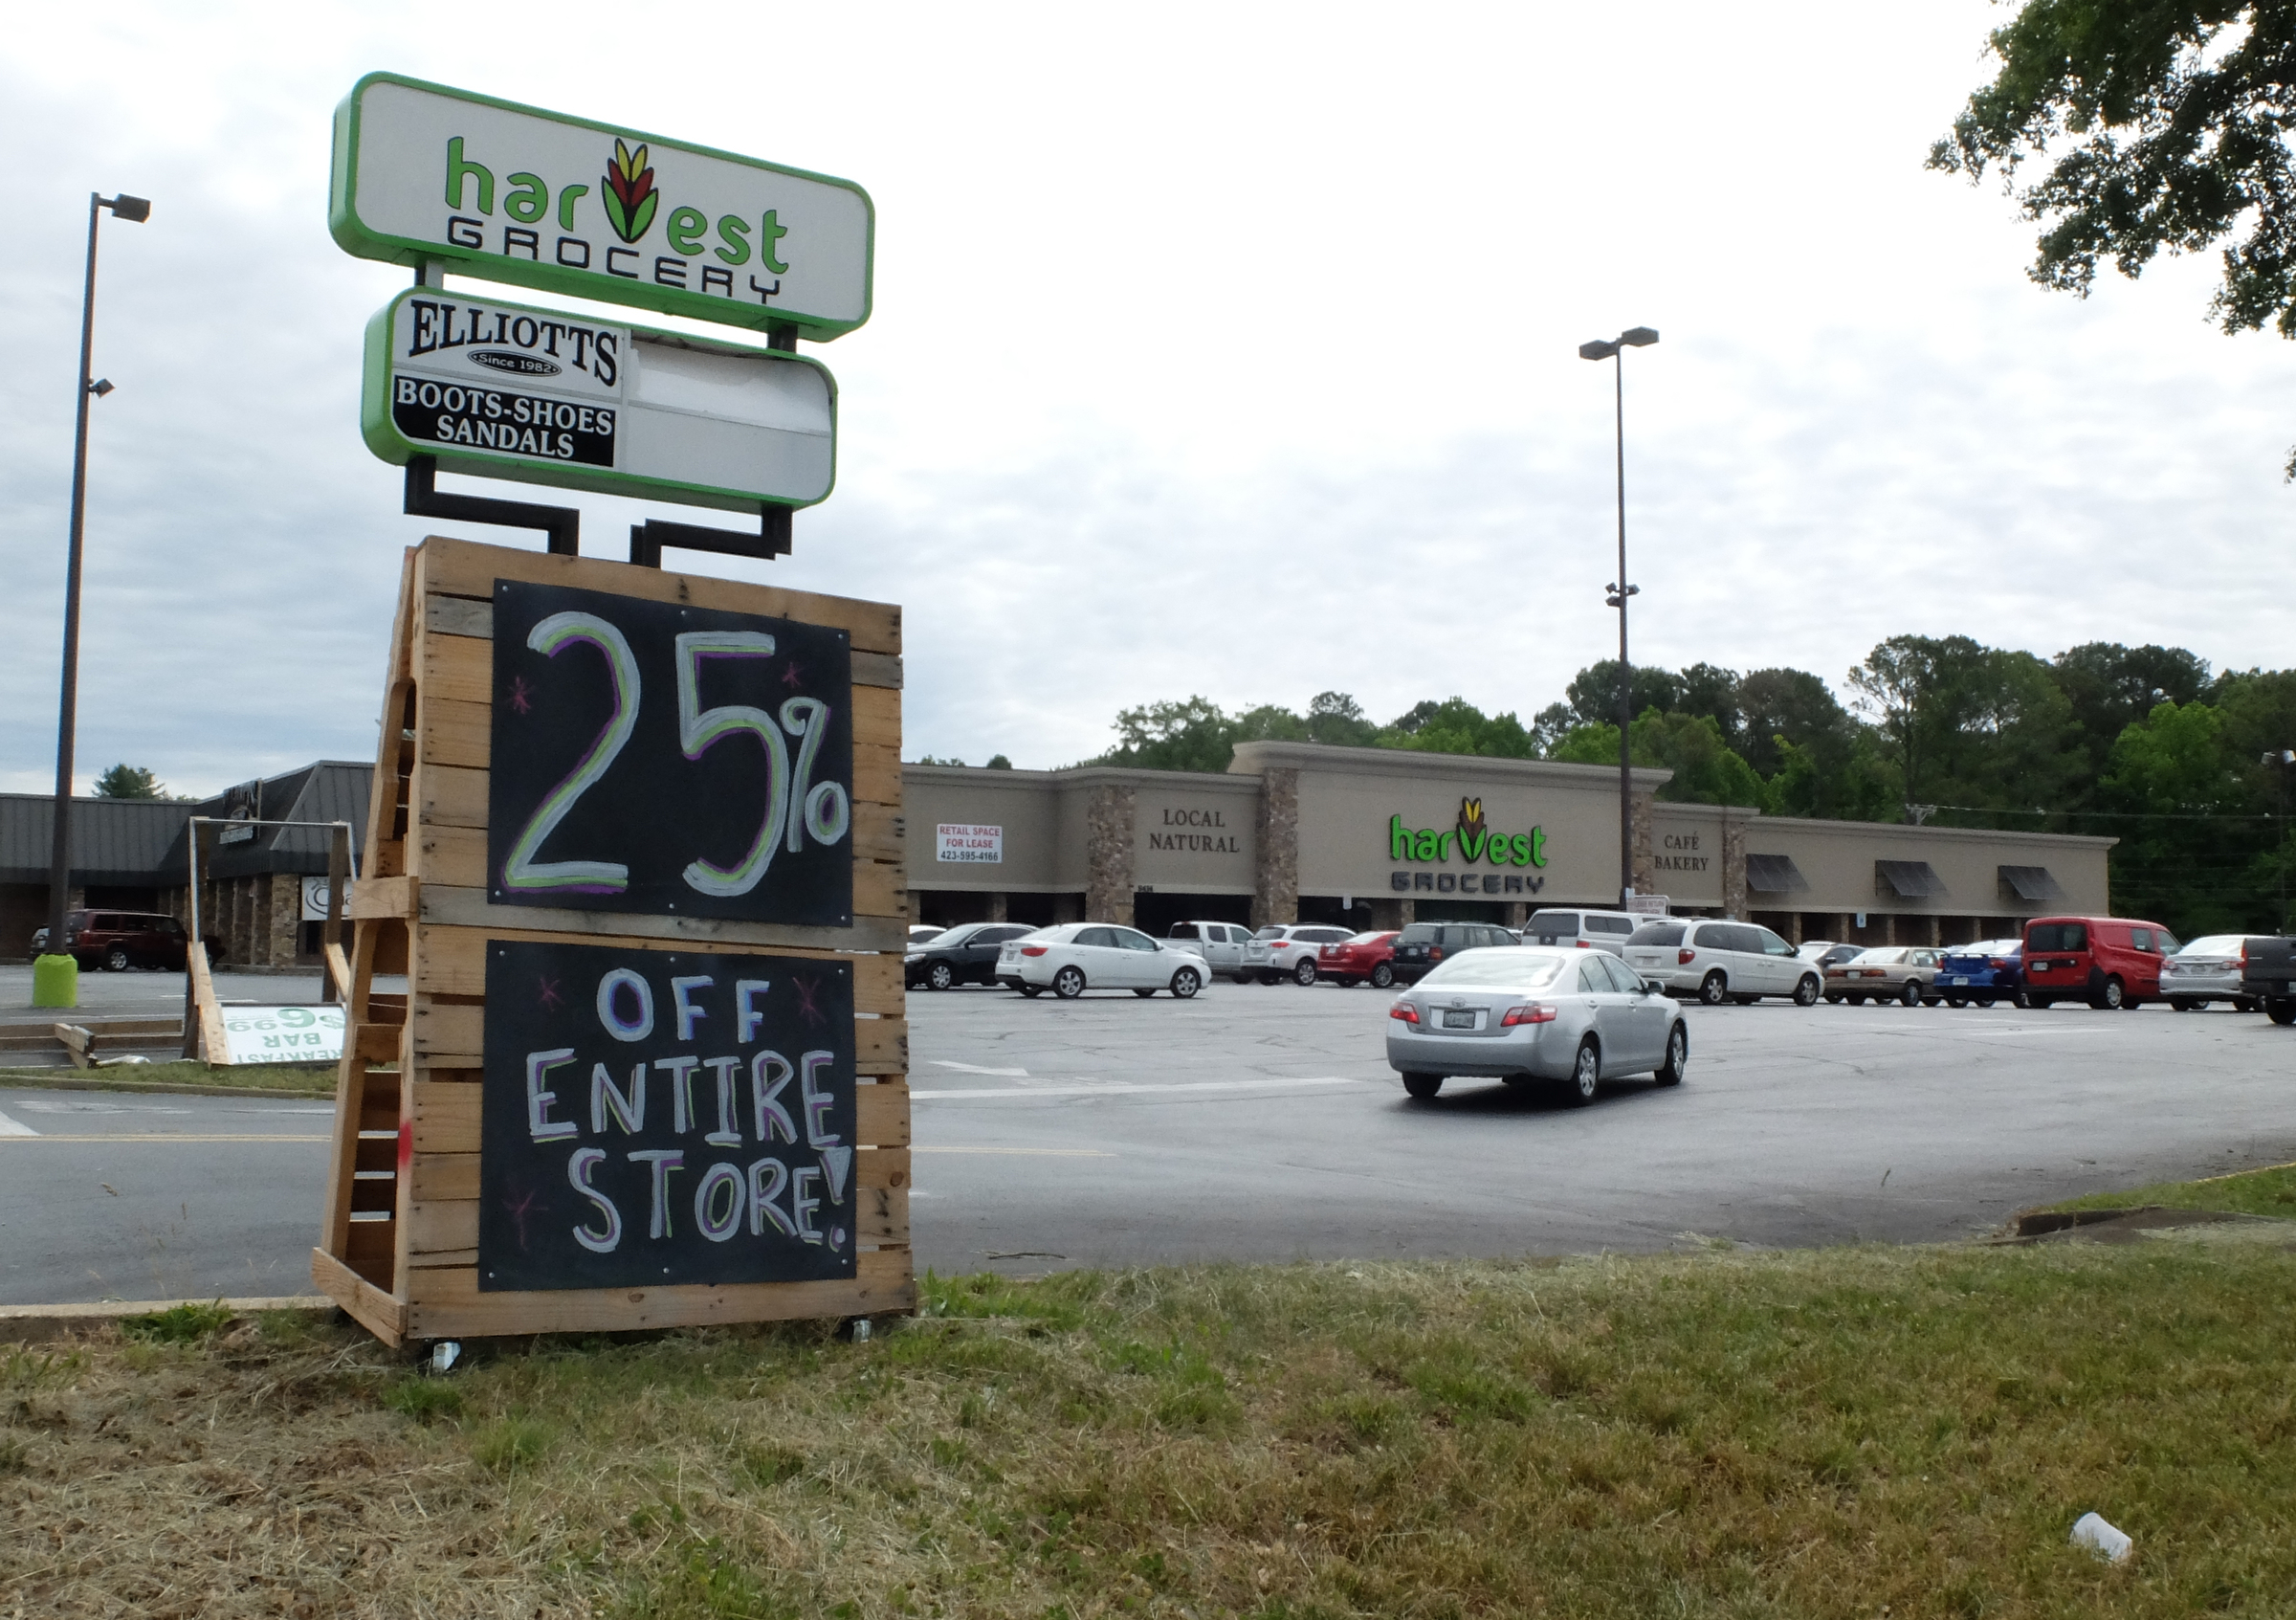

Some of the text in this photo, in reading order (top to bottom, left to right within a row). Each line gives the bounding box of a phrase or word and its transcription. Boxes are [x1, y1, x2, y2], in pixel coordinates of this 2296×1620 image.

[447, 215, 781, 304] GROCERY
[408, 299, 617, 388] ELLIOTTS
[478, 353, 552, 373] Since 1982
[397, 378, 613, 436] BOOTS-SHOES
[436, 414, 575, 459] SANDALS
[500, 610, 850, 898] 25%
[1163, 809, 1226, 828] LOCAL
[939, 826, 1000, 836] RETAIL SPACE
[1665, 831, 1700, 850] CAFÉ
[946, 838, 993, 849] FOR LEASE
[1149, 832, 1240, 853] NATURAL
[940, 851, 999, 861] 423-595-4166
[1654, 855, 1710, 871] BAKERY
[1391, 871, 1545, 895] GROCERY
[597, 967, 770, 1043] OFF
[262, 1032, 322, 1048] BAR
[237, 1050, 343, 1063] REAKFAST
[526, 1048, 842, 1150] ENTIRE
[568, 1146, 852, 1254] STORE!
